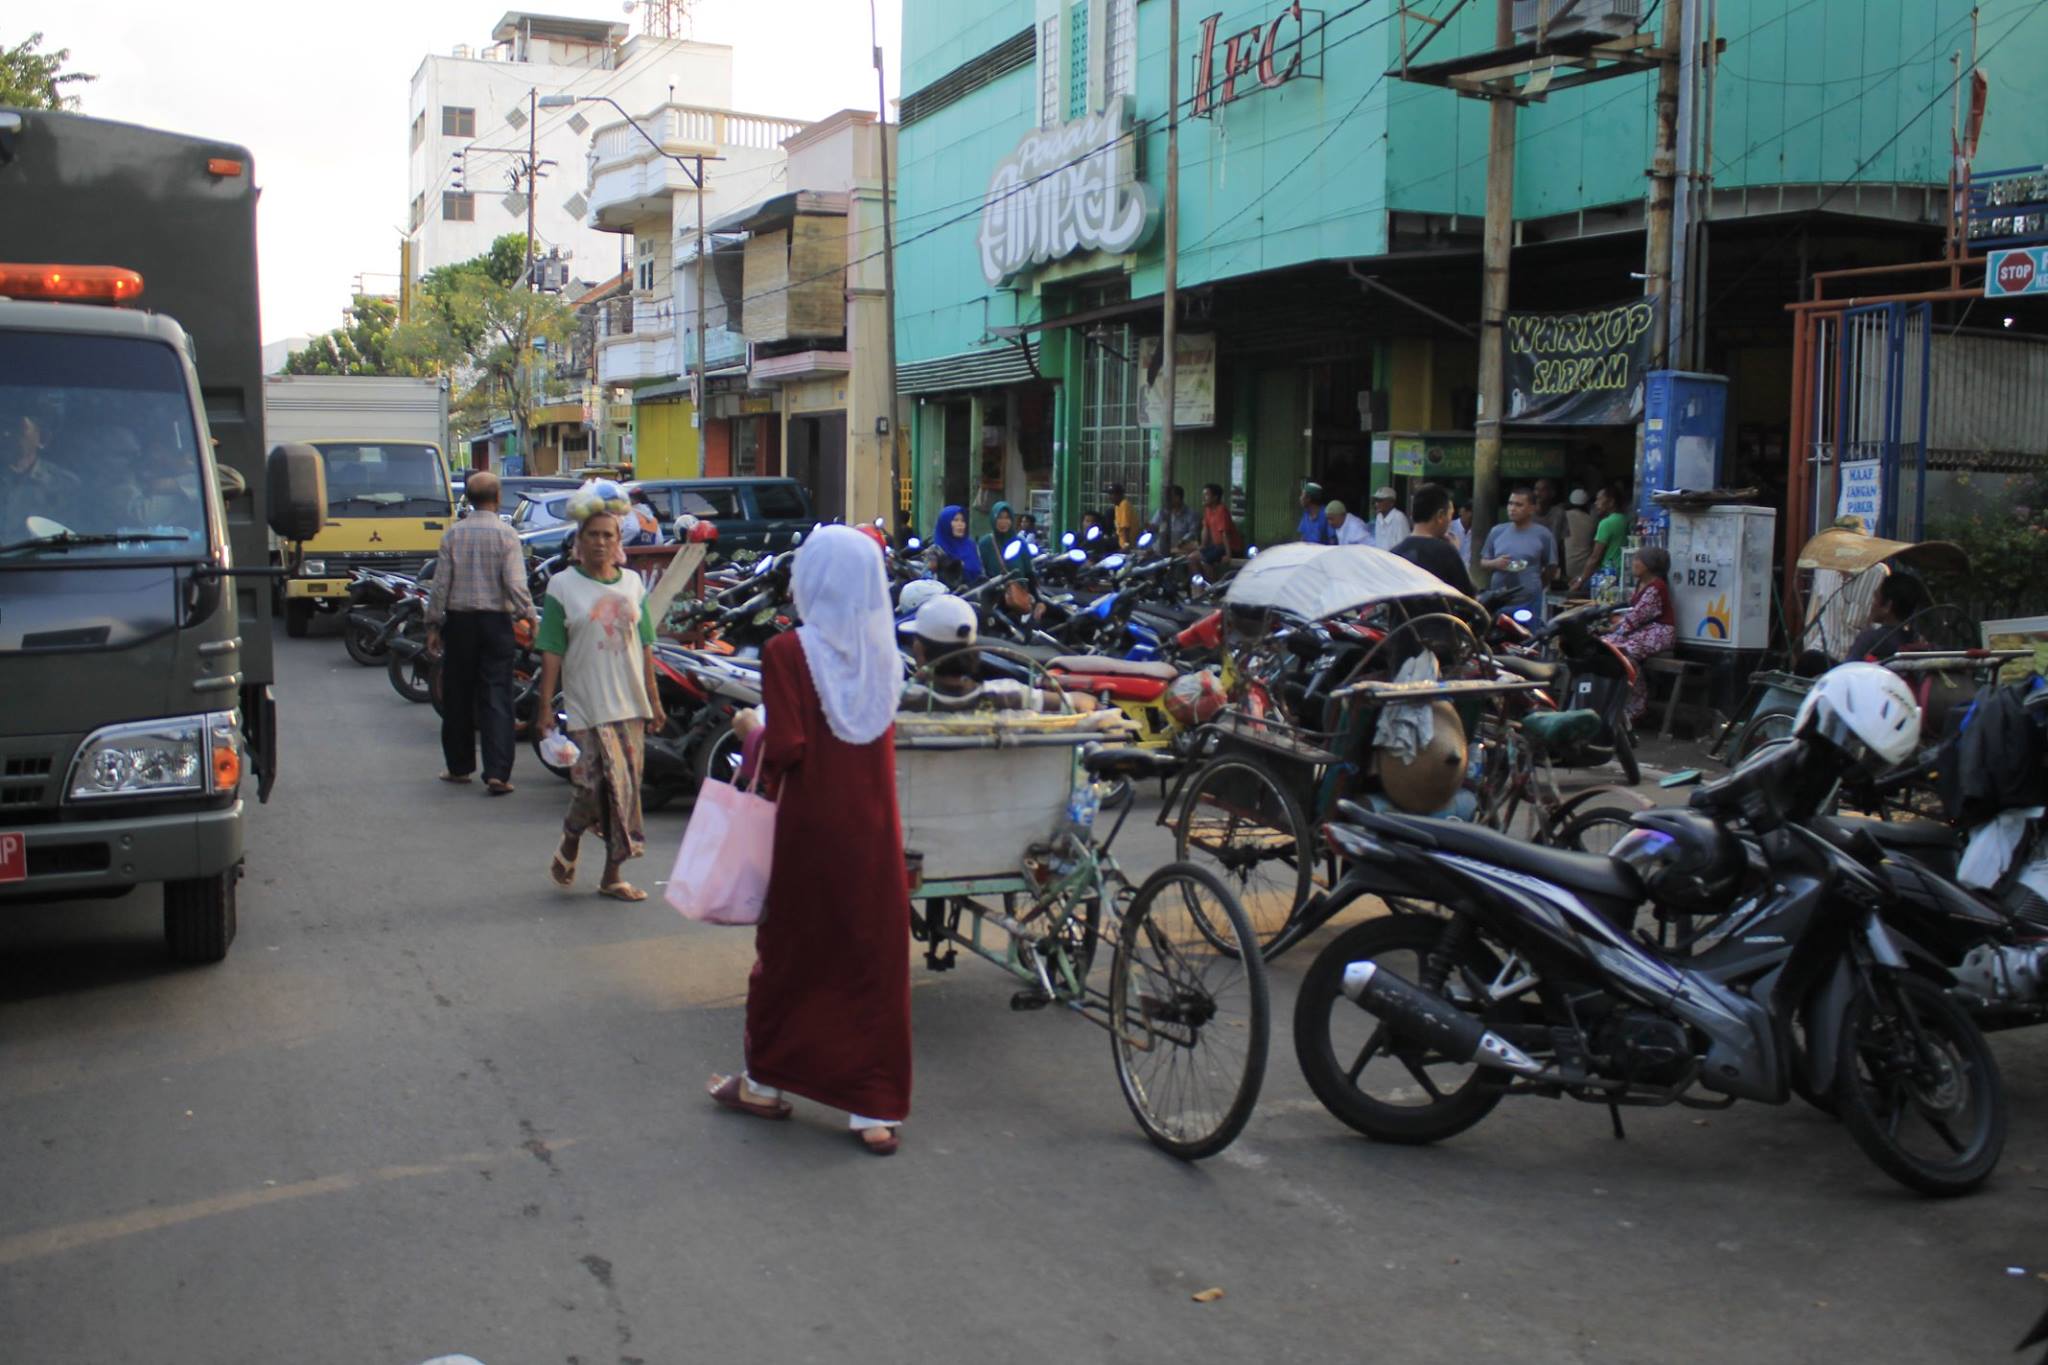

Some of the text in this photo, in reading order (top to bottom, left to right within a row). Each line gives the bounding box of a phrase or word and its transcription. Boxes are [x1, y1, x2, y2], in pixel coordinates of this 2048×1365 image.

[1190, 0, 1300, 118] IFC
[2000, 264, 2031, 280] STOP
[1508, 303, 1653, 353] WARKOP
[1532, 353, 1629, 394] SARKAM
[1849, 468, 1874, 481] MAAF
[1688, 569, 1718, 587] RBZ
